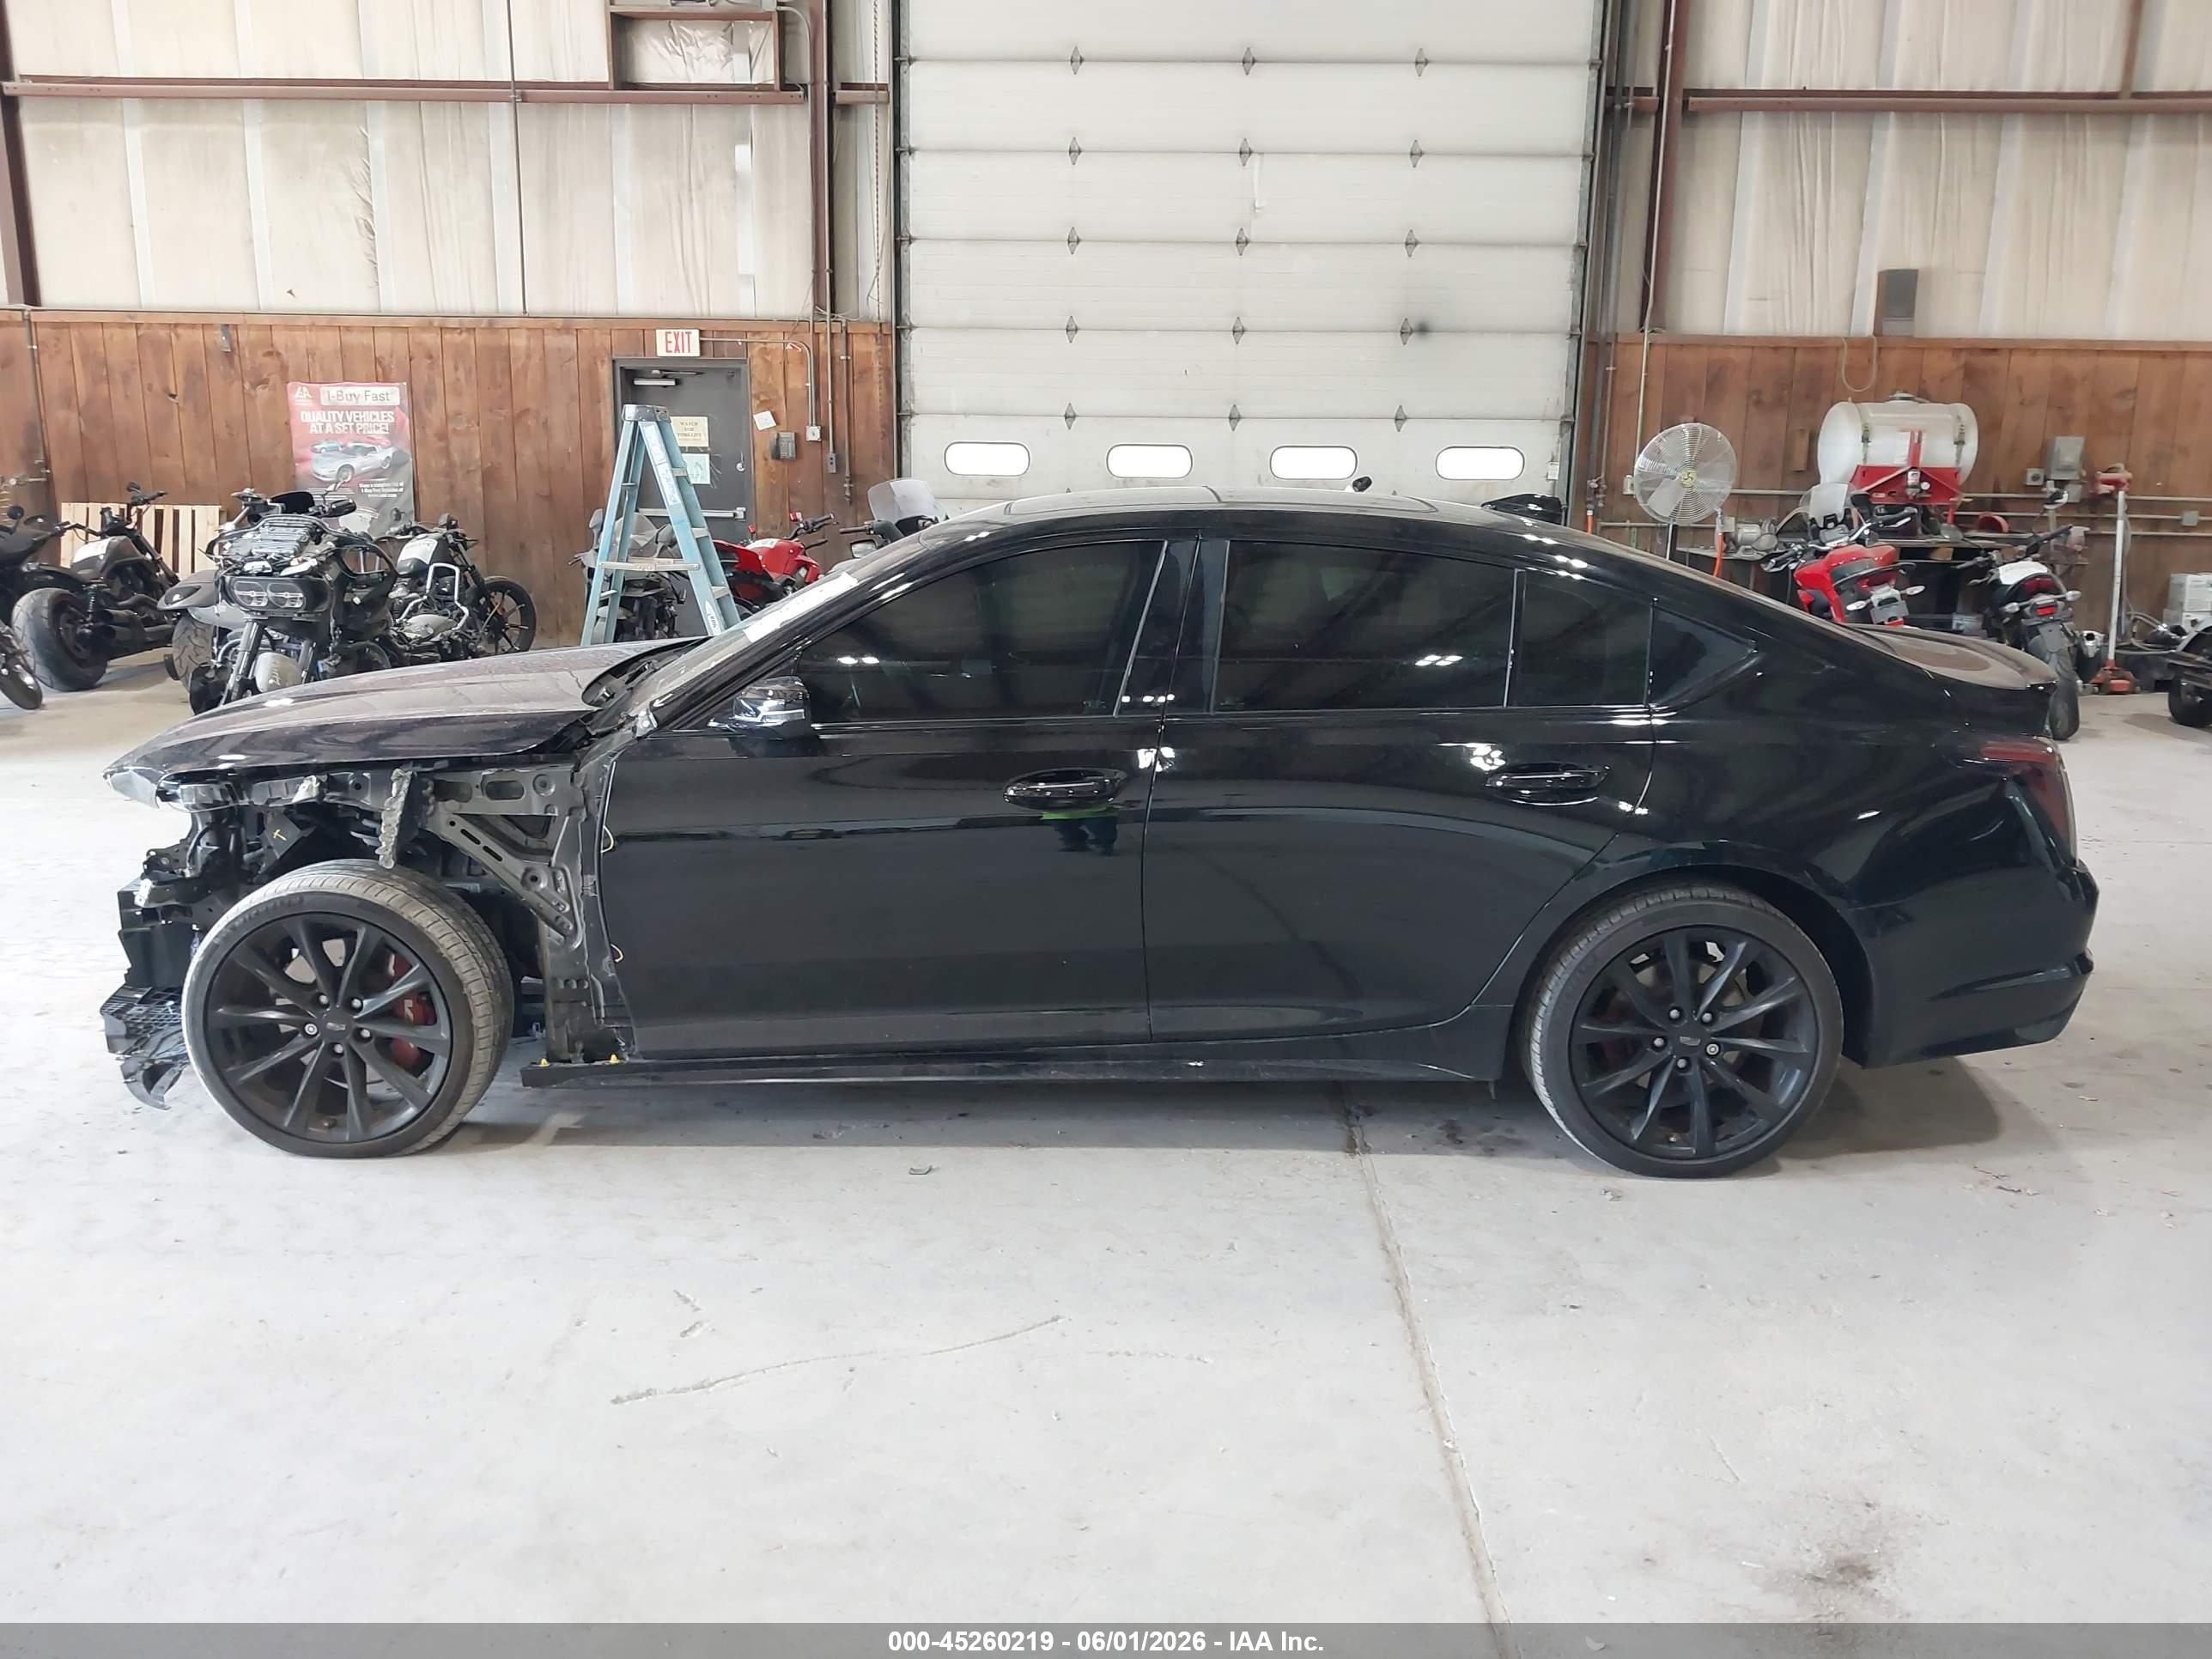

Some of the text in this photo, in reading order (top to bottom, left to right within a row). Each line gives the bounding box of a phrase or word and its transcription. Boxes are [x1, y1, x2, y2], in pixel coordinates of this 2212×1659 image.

[665, 331, 692, 353] EXIT
[327, 390, 361, 403] I-Buy
[364, 390, 391, 402] Fast
[300, 410, 395, 422] QUALITY VEHICLES
[309, 422, 390, 434] AT A SET PRICE!
